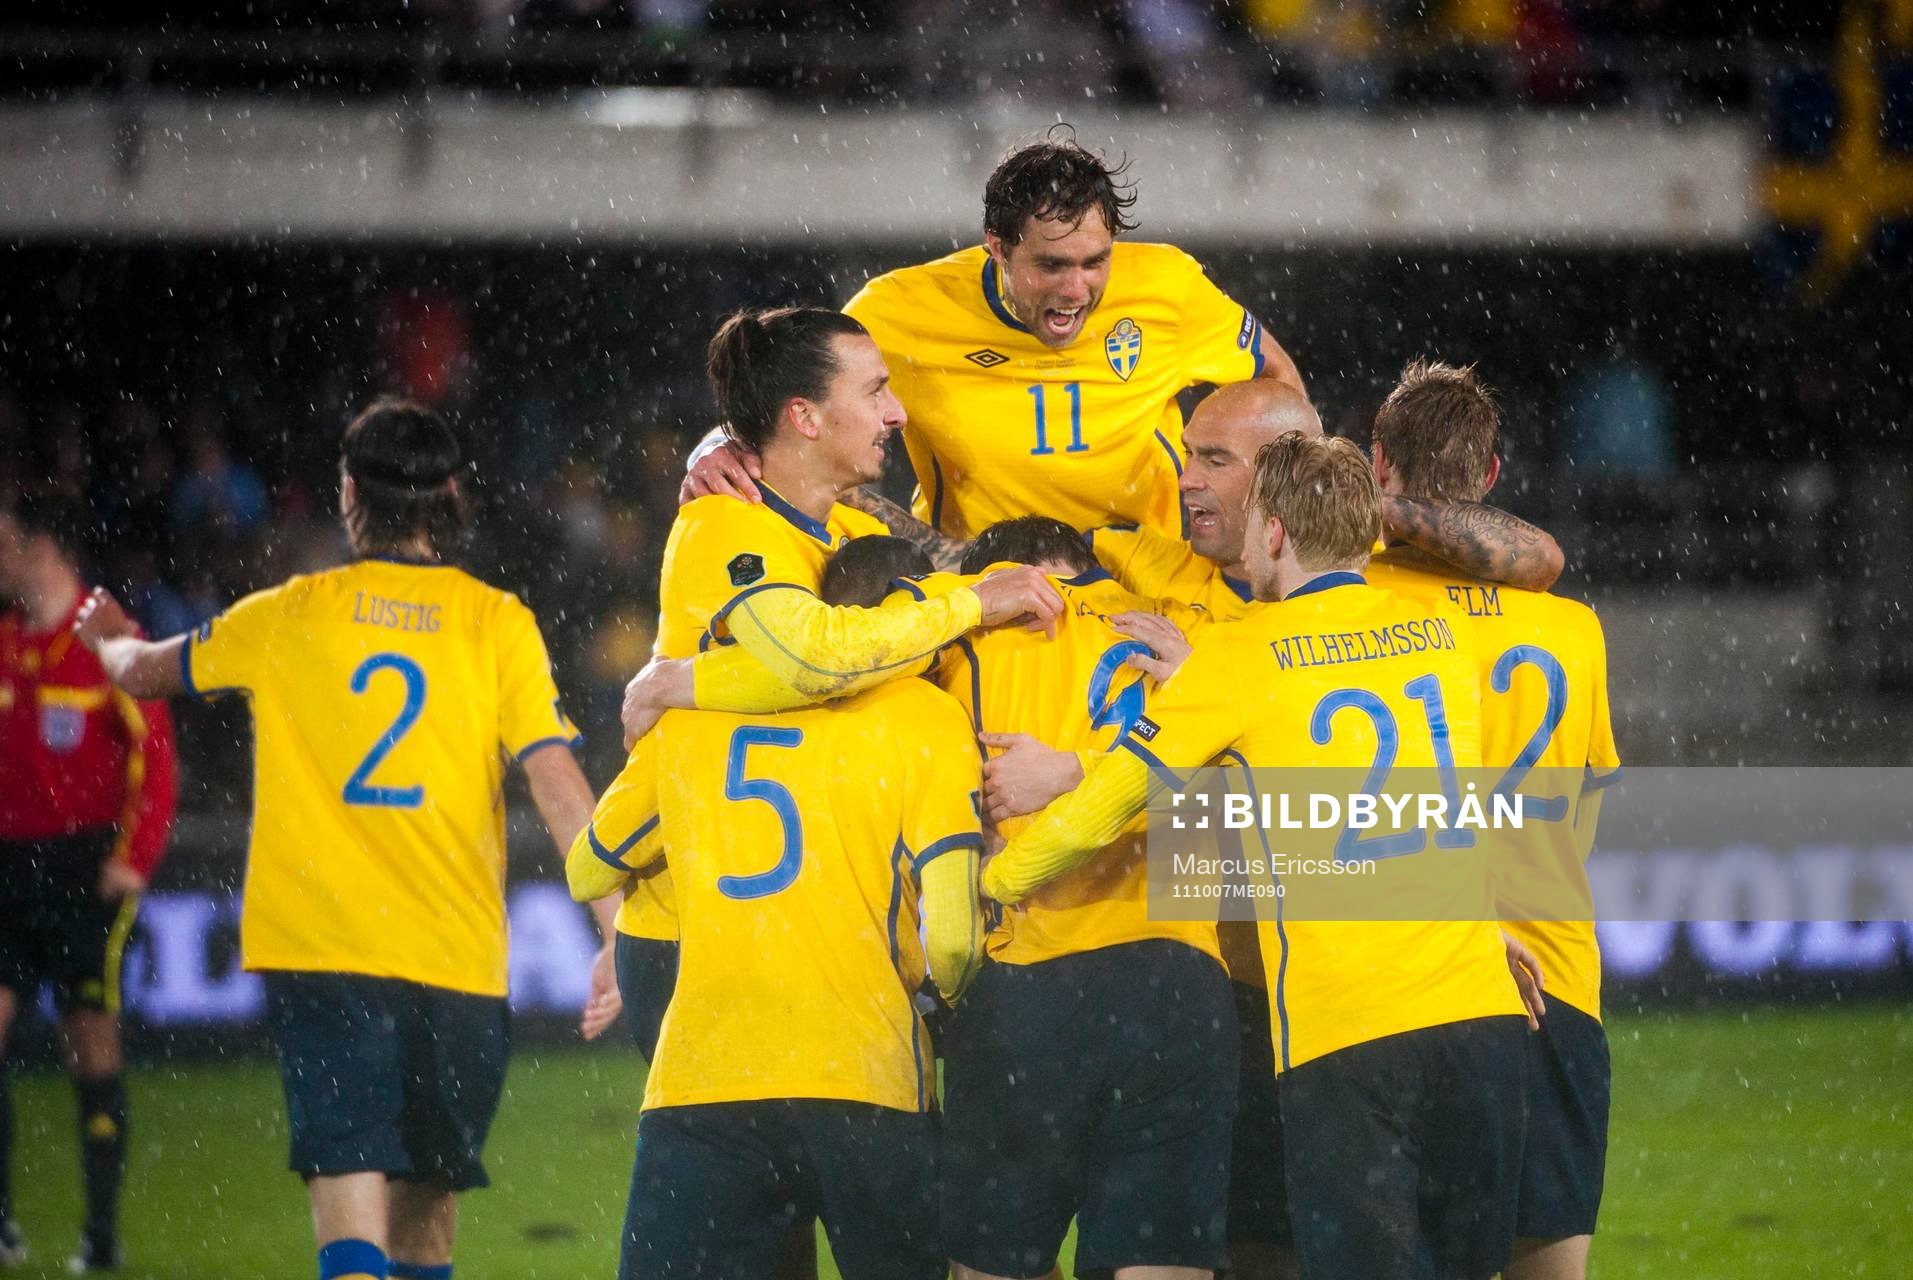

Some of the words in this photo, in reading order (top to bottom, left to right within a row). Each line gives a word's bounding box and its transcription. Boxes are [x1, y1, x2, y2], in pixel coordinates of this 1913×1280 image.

[1027, 382, 1089, 455] 11
[353, 591, 442, 633] LUSTIG
[1269, 617, 1456, 671] WILHELMSSON
[342, 652, 427, 808] 2
[1310, 674, 1477, 862] 21
[718, 725, 803, 900] 5
